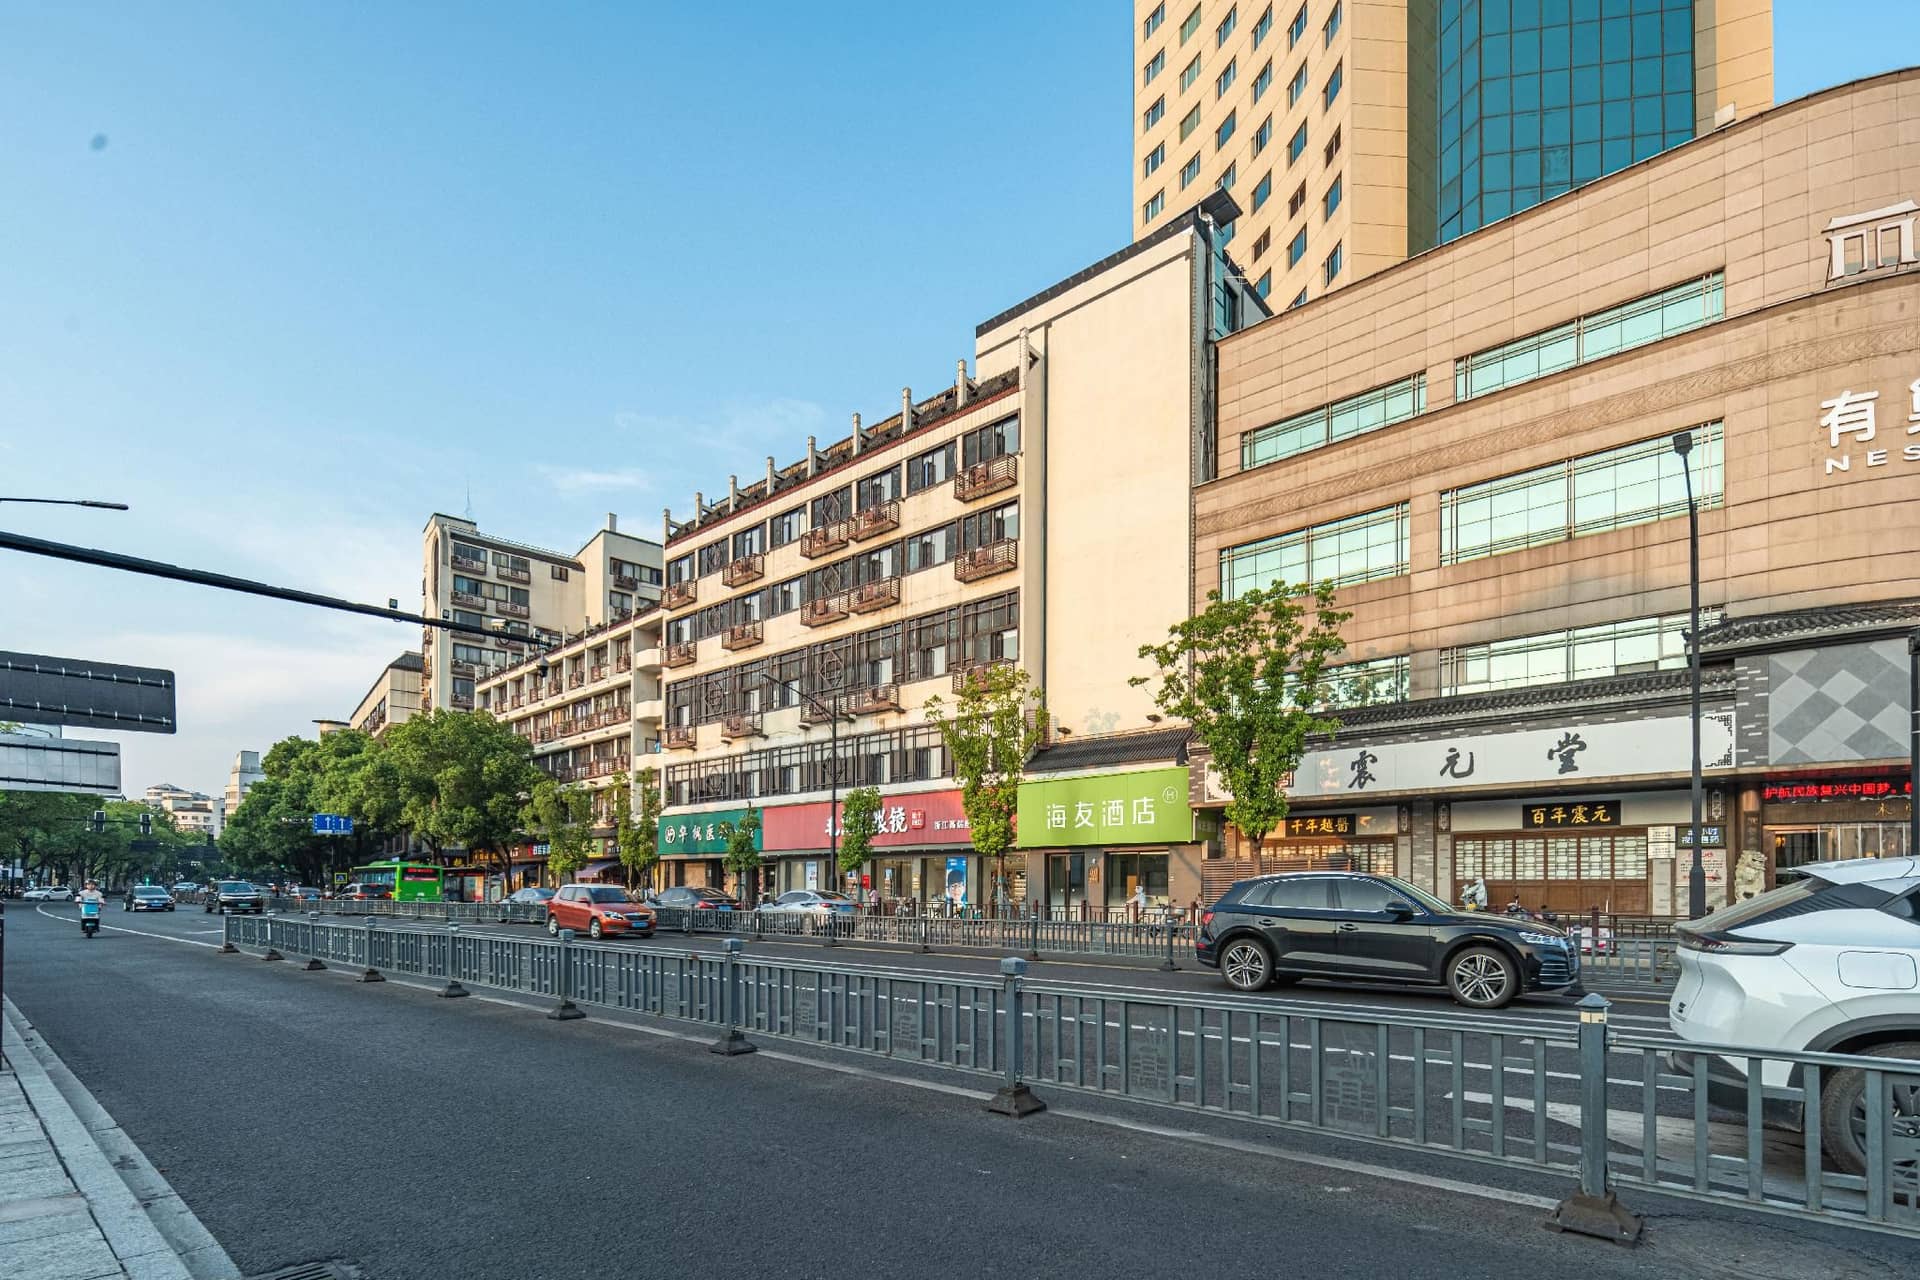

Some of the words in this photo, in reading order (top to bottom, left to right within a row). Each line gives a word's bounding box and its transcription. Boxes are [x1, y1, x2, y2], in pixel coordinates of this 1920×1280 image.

[1820, 377, 1920, 448] 有
[1347, 731, 1588, 790] 震元堂
[1046, 796, 1156, 831] 海友酒店
[1531, 804, 1612, 825] 百年震元
